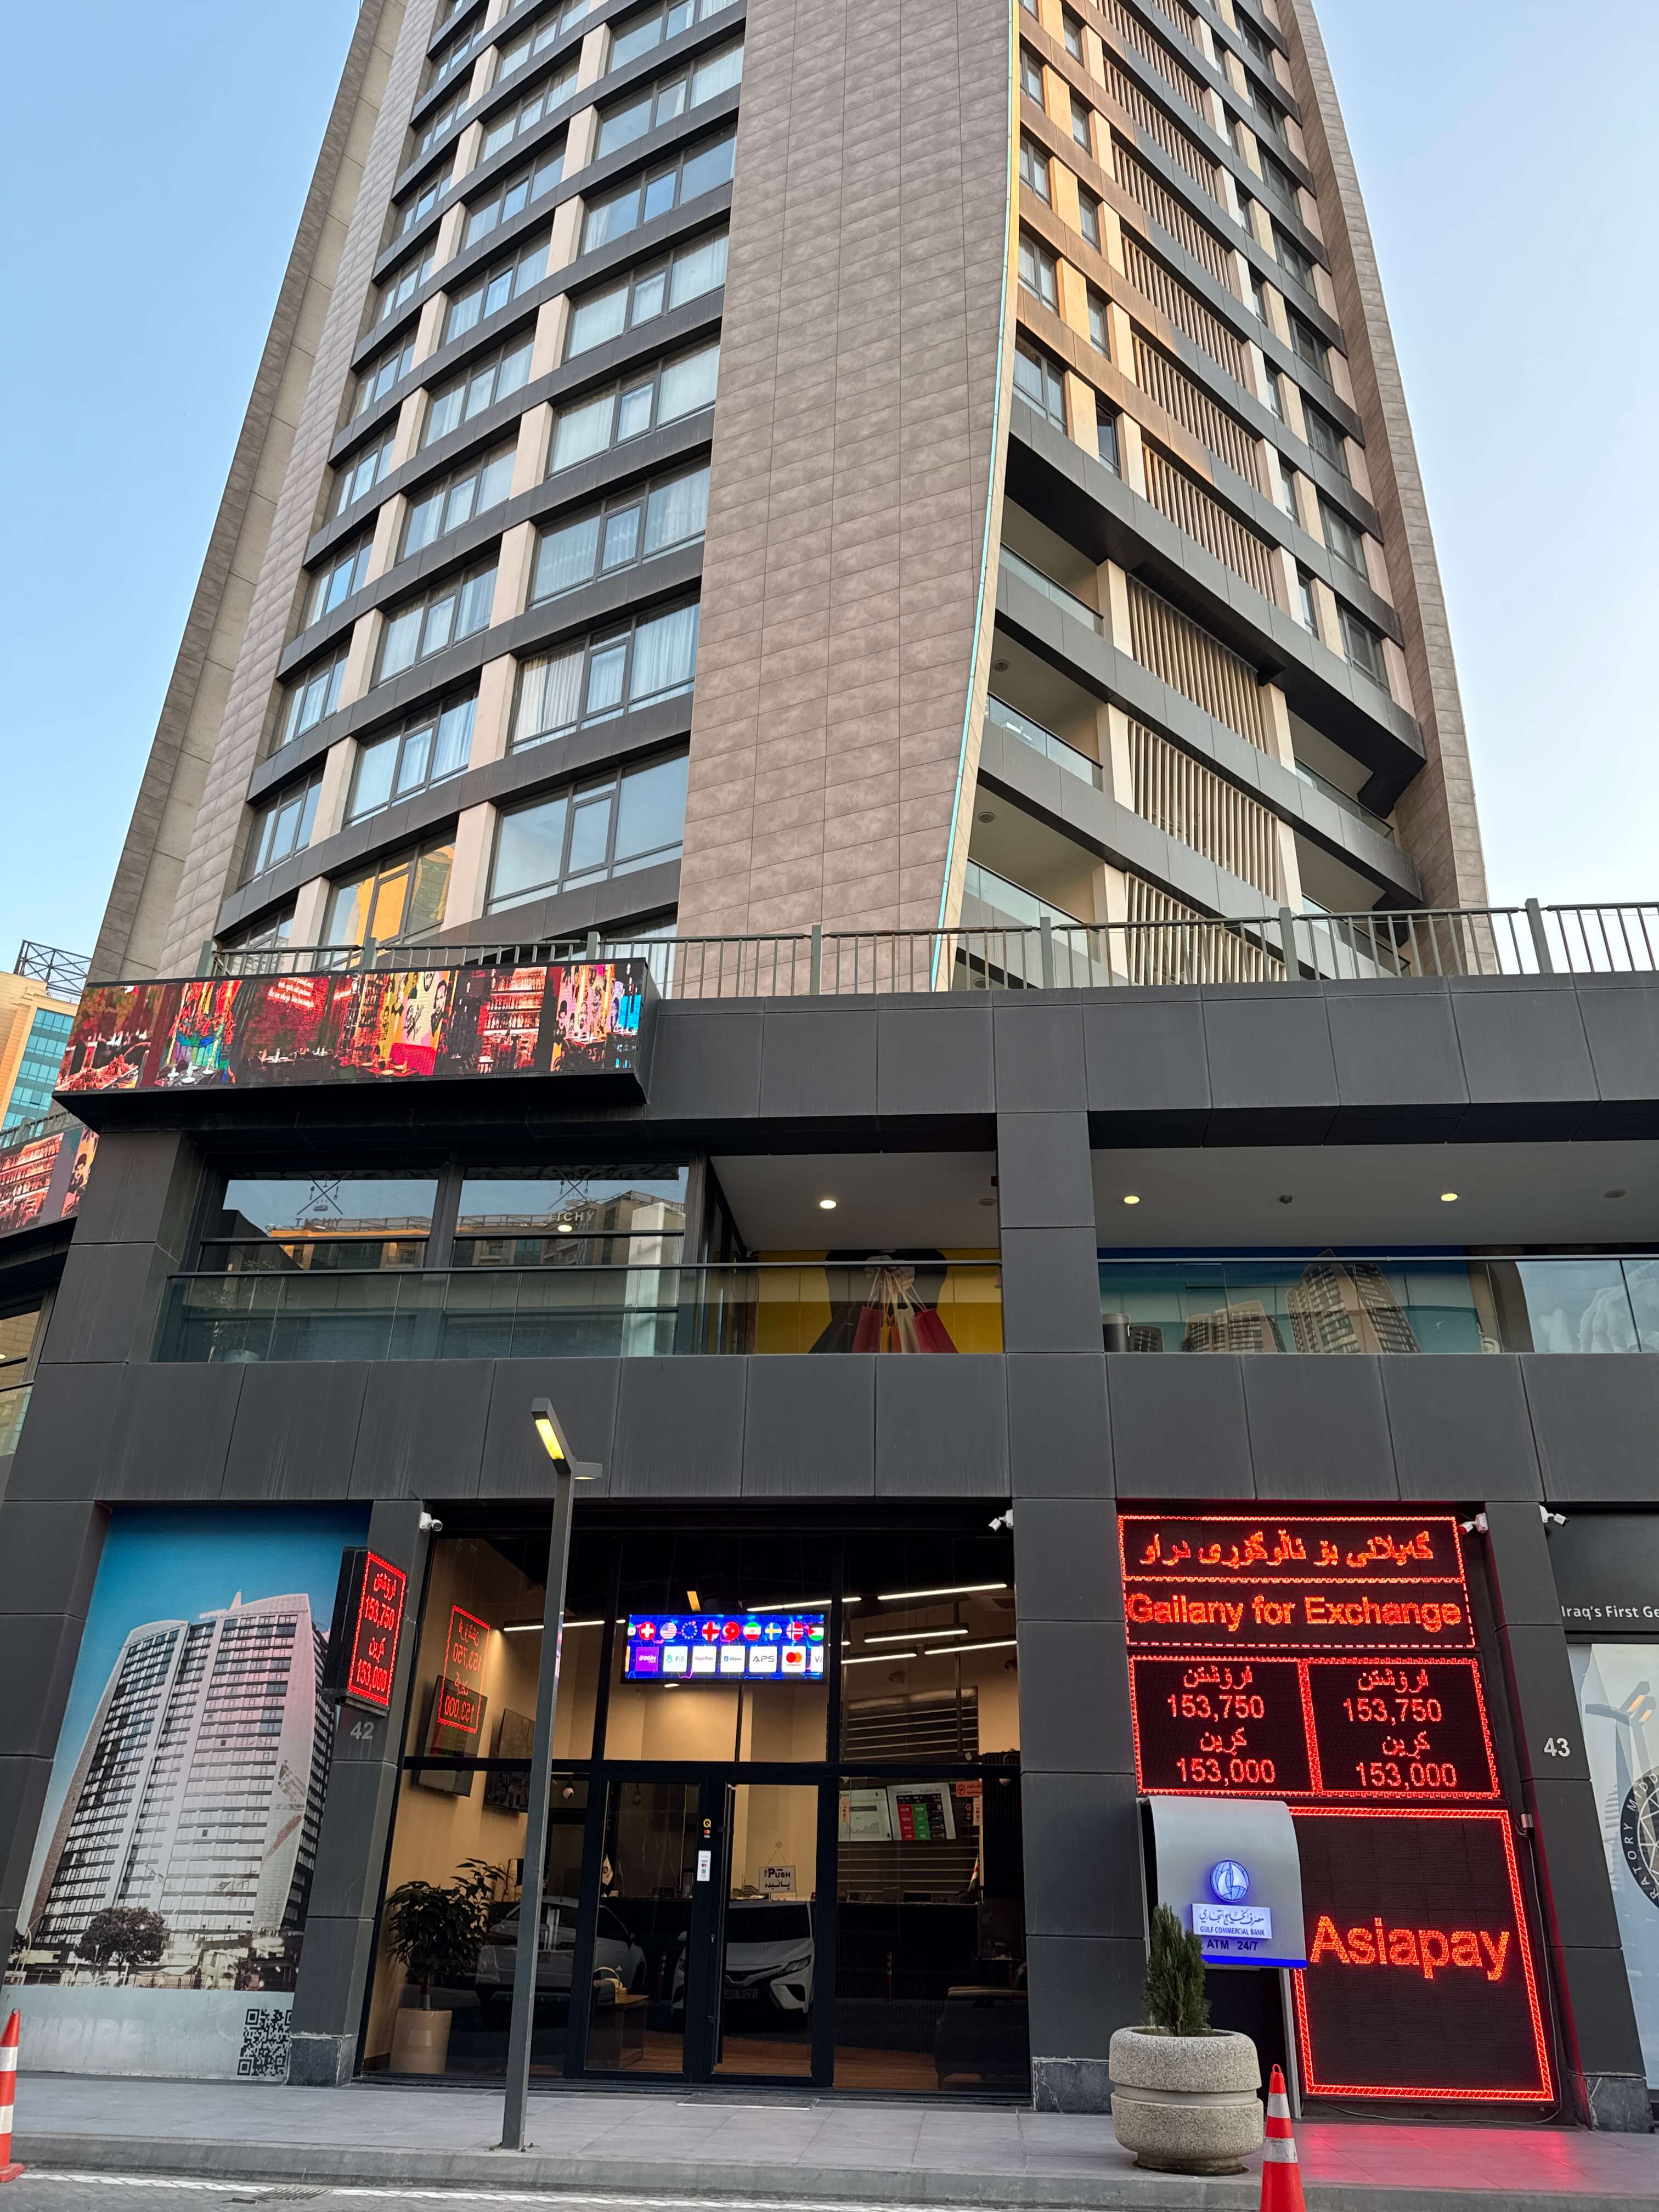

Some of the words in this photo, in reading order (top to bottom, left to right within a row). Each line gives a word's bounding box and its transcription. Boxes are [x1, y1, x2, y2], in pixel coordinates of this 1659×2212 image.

[295, 1217, 342, 1227] TICHY
[1139, 1534, 1191, 1566] دراو
[1313, 1540, 1339, 1566] بۆ
[365, 1595, 396, 1630] 153,750
[1127, 1593, 1244, 1633] Gailany
[1251, 1594, 1296, 1625] for
[1304, 1596, 1462, 1633] Exchange
[1561, 1605, 1602, 1621] Iraq's
[1605, 1605, 1639, 1618] First
[357, 1658, 387, 1692] 153,000
[1167, 1694, 1265, 1723] 153,750
[1342, 1697, 1442, 1726] 153,750
[350, 1722, 374, 1740] 42
[1544, 1737, 1571, 1757] 43
[1177, 1757, 1276, 1787] 153,000
[1356, 1762, 1457, 1790] 153,000
[1207, 1939, 1229, 1949] ATM
[1237, 1941, 1258, 1951] 24/7
[1215, 1926, 1249, 1936] COMMERCIAL
[1310, 1915, 1510, 1980] Asiapay
